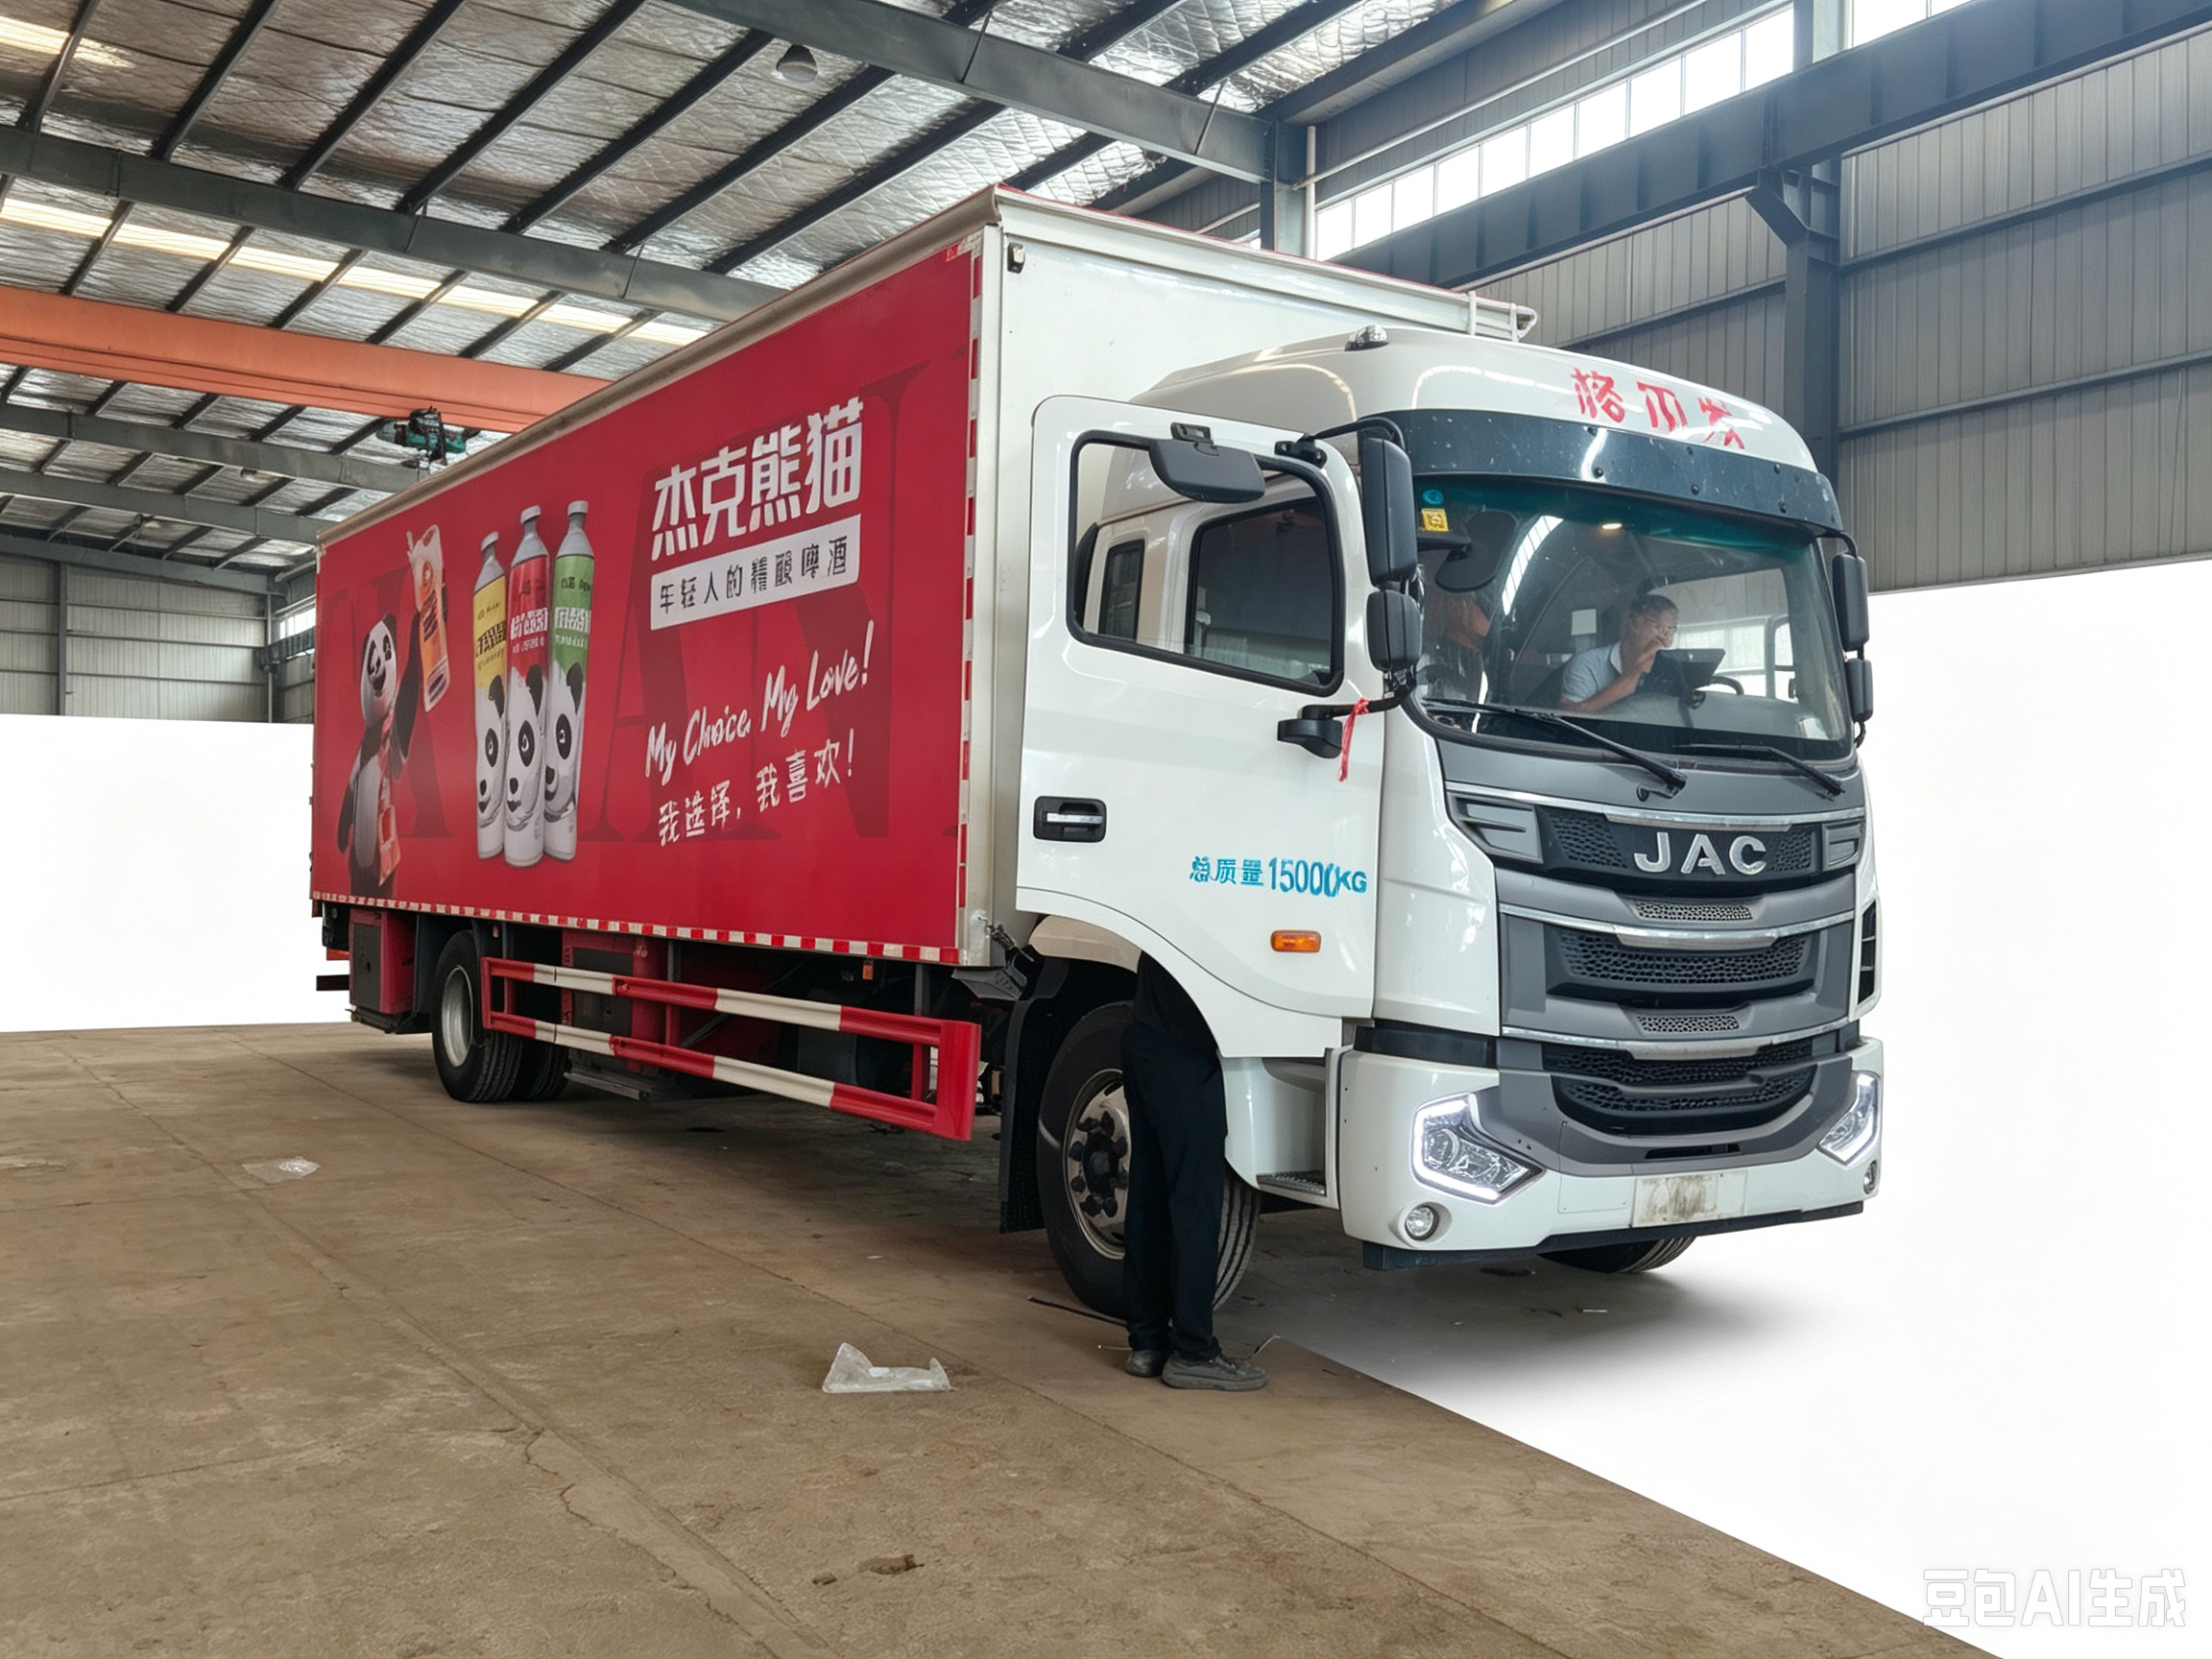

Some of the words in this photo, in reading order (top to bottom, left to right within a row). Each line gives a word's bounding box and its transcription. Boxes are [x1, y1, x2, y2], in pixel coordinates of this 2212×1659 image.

[651, 397, 863, 561] 杰克熊猫
[645, 722, 677, 786] My
[760, 665, 799, 738] My
[806, 619, 875, 711] Love!
[1633, 832, 1767, 876] JAC
